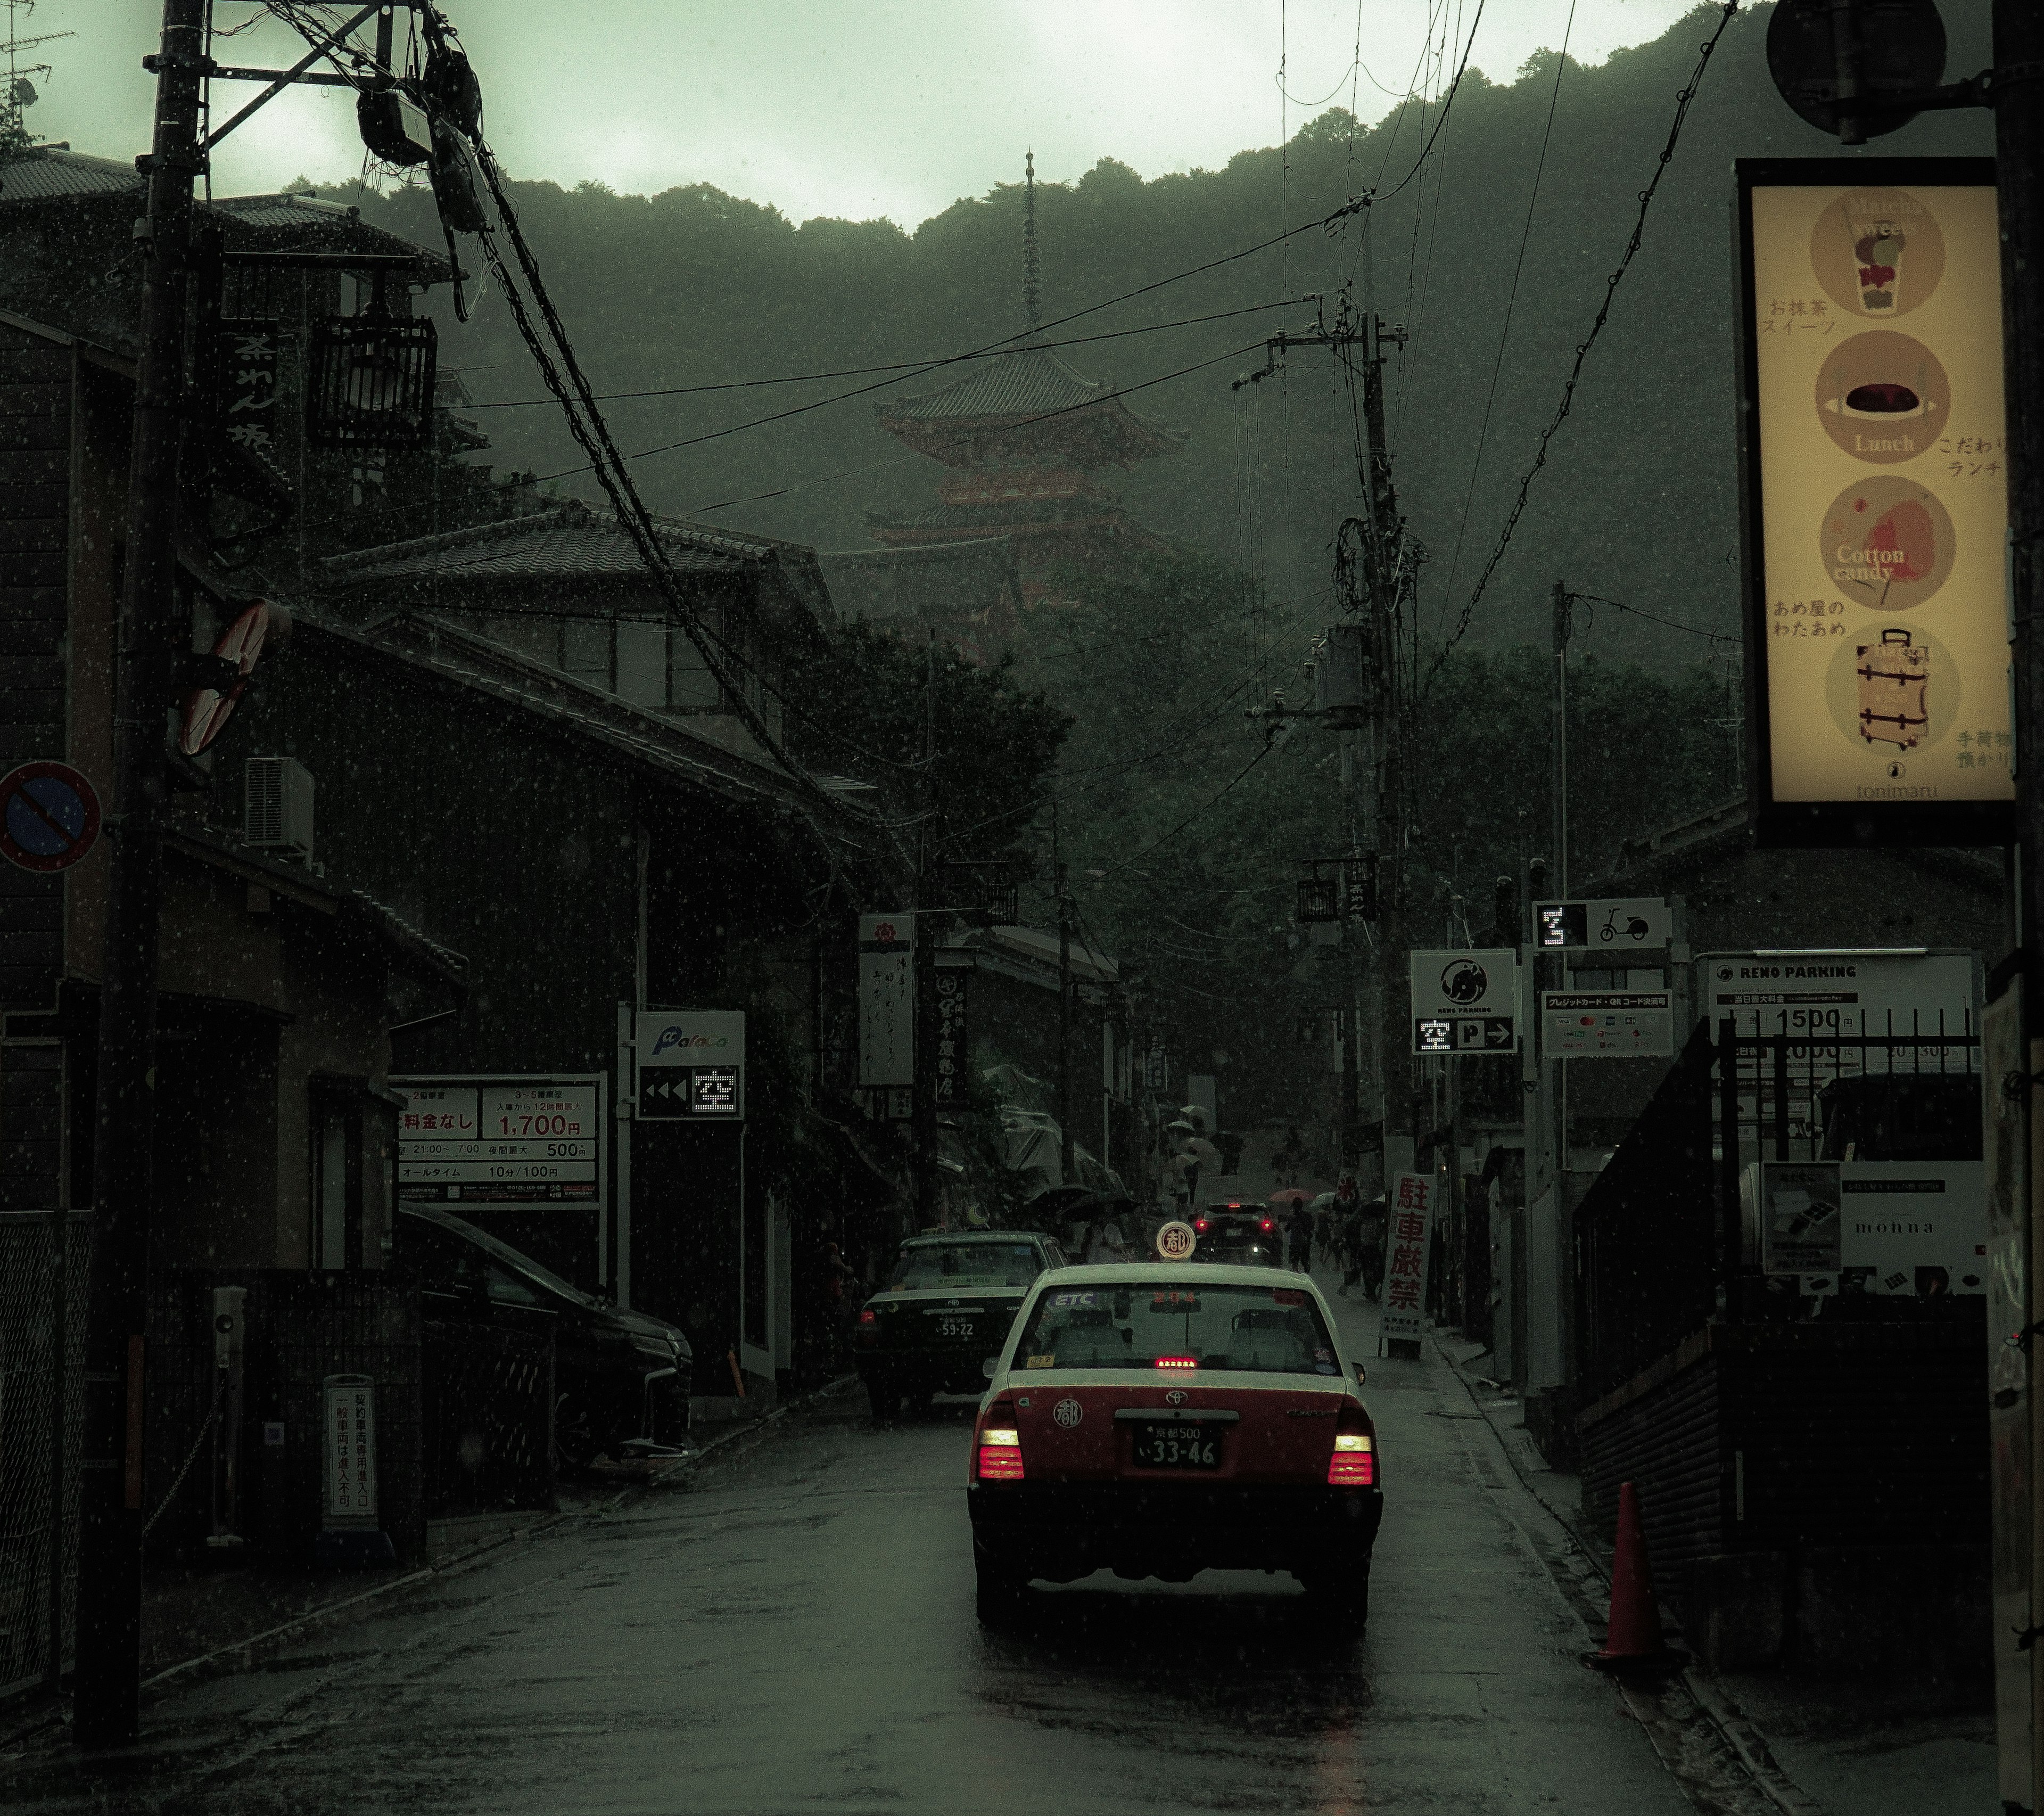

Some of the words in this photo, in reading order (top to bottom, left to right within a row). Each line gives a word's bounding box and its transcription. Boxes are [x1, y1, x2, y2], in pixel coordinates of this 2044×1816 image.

[1770, 299, 1827, 315] お抹茶
[1762, 320, 1836, 335] スイーツ
[227, 336, 276, 448] 茶わん坂
[1855, 435, 1916, 452] Lunch
[1948, 462, 2001, 477] ランチ
[1835, 545, 1906, 564] Cotton
[1834, 562, 1894, 584] candy
[1773, 601, 1845, 617] あめ屋の
[1773, 621, 1847, 637] わたあめ
[1956, 752, 2009, 769] 預かり
[1741, 967, 1779, 979] RENO
[1785, 966, 1857, 979] PARKING
[1421, 1020, 1450, 1050] 空
[1463, 1025, 1479, 1043] P
[695, 1070, 734, 1110] 空
[500, 1115, 580, 1136] 1,700円
[402, 1168, 461, 1178] オールタイム
[1387, 1177, 1429, 1311] 駐車厳禁
[1056, 1293, 1095, 1306] ETC
[336, 1398, 350, 1508] 一般車両は進入不可
[355, 1394, 368, 1507] 契約車両専用進入口
[1153, 1440, 1215, 1465] 33-46
